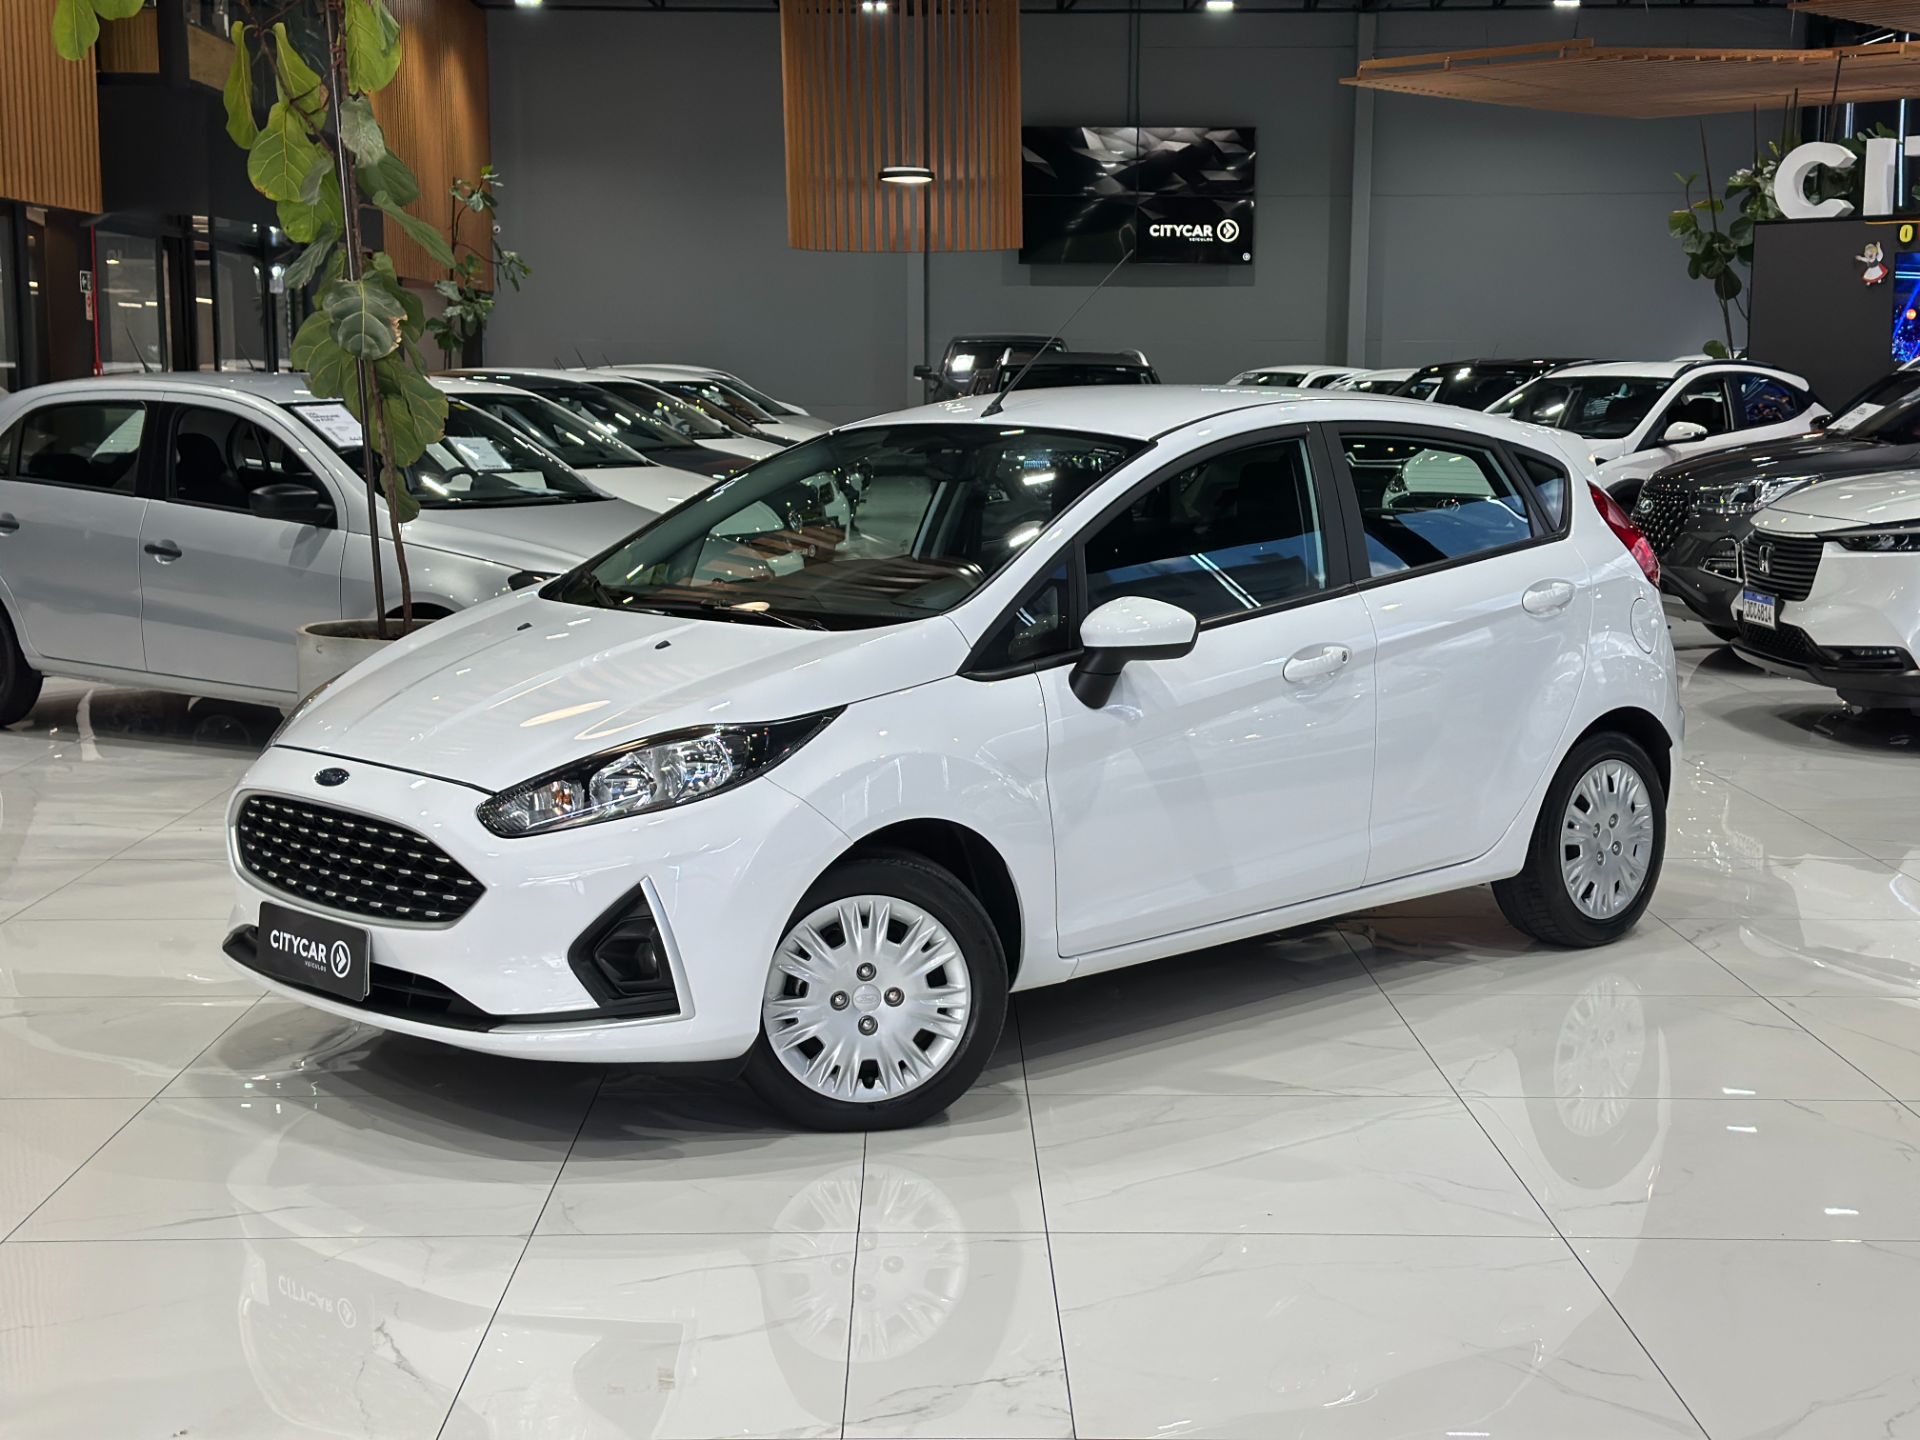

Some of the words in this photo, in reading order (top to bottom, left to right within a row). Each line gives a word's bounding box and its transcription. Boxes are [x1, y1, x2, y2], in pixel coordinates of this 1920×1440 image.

[1774, 136, 1920, 219] CI
[1149, 224, 1213, 237] CITYCAR
[270, 929, 327, 964] CITYCAR
